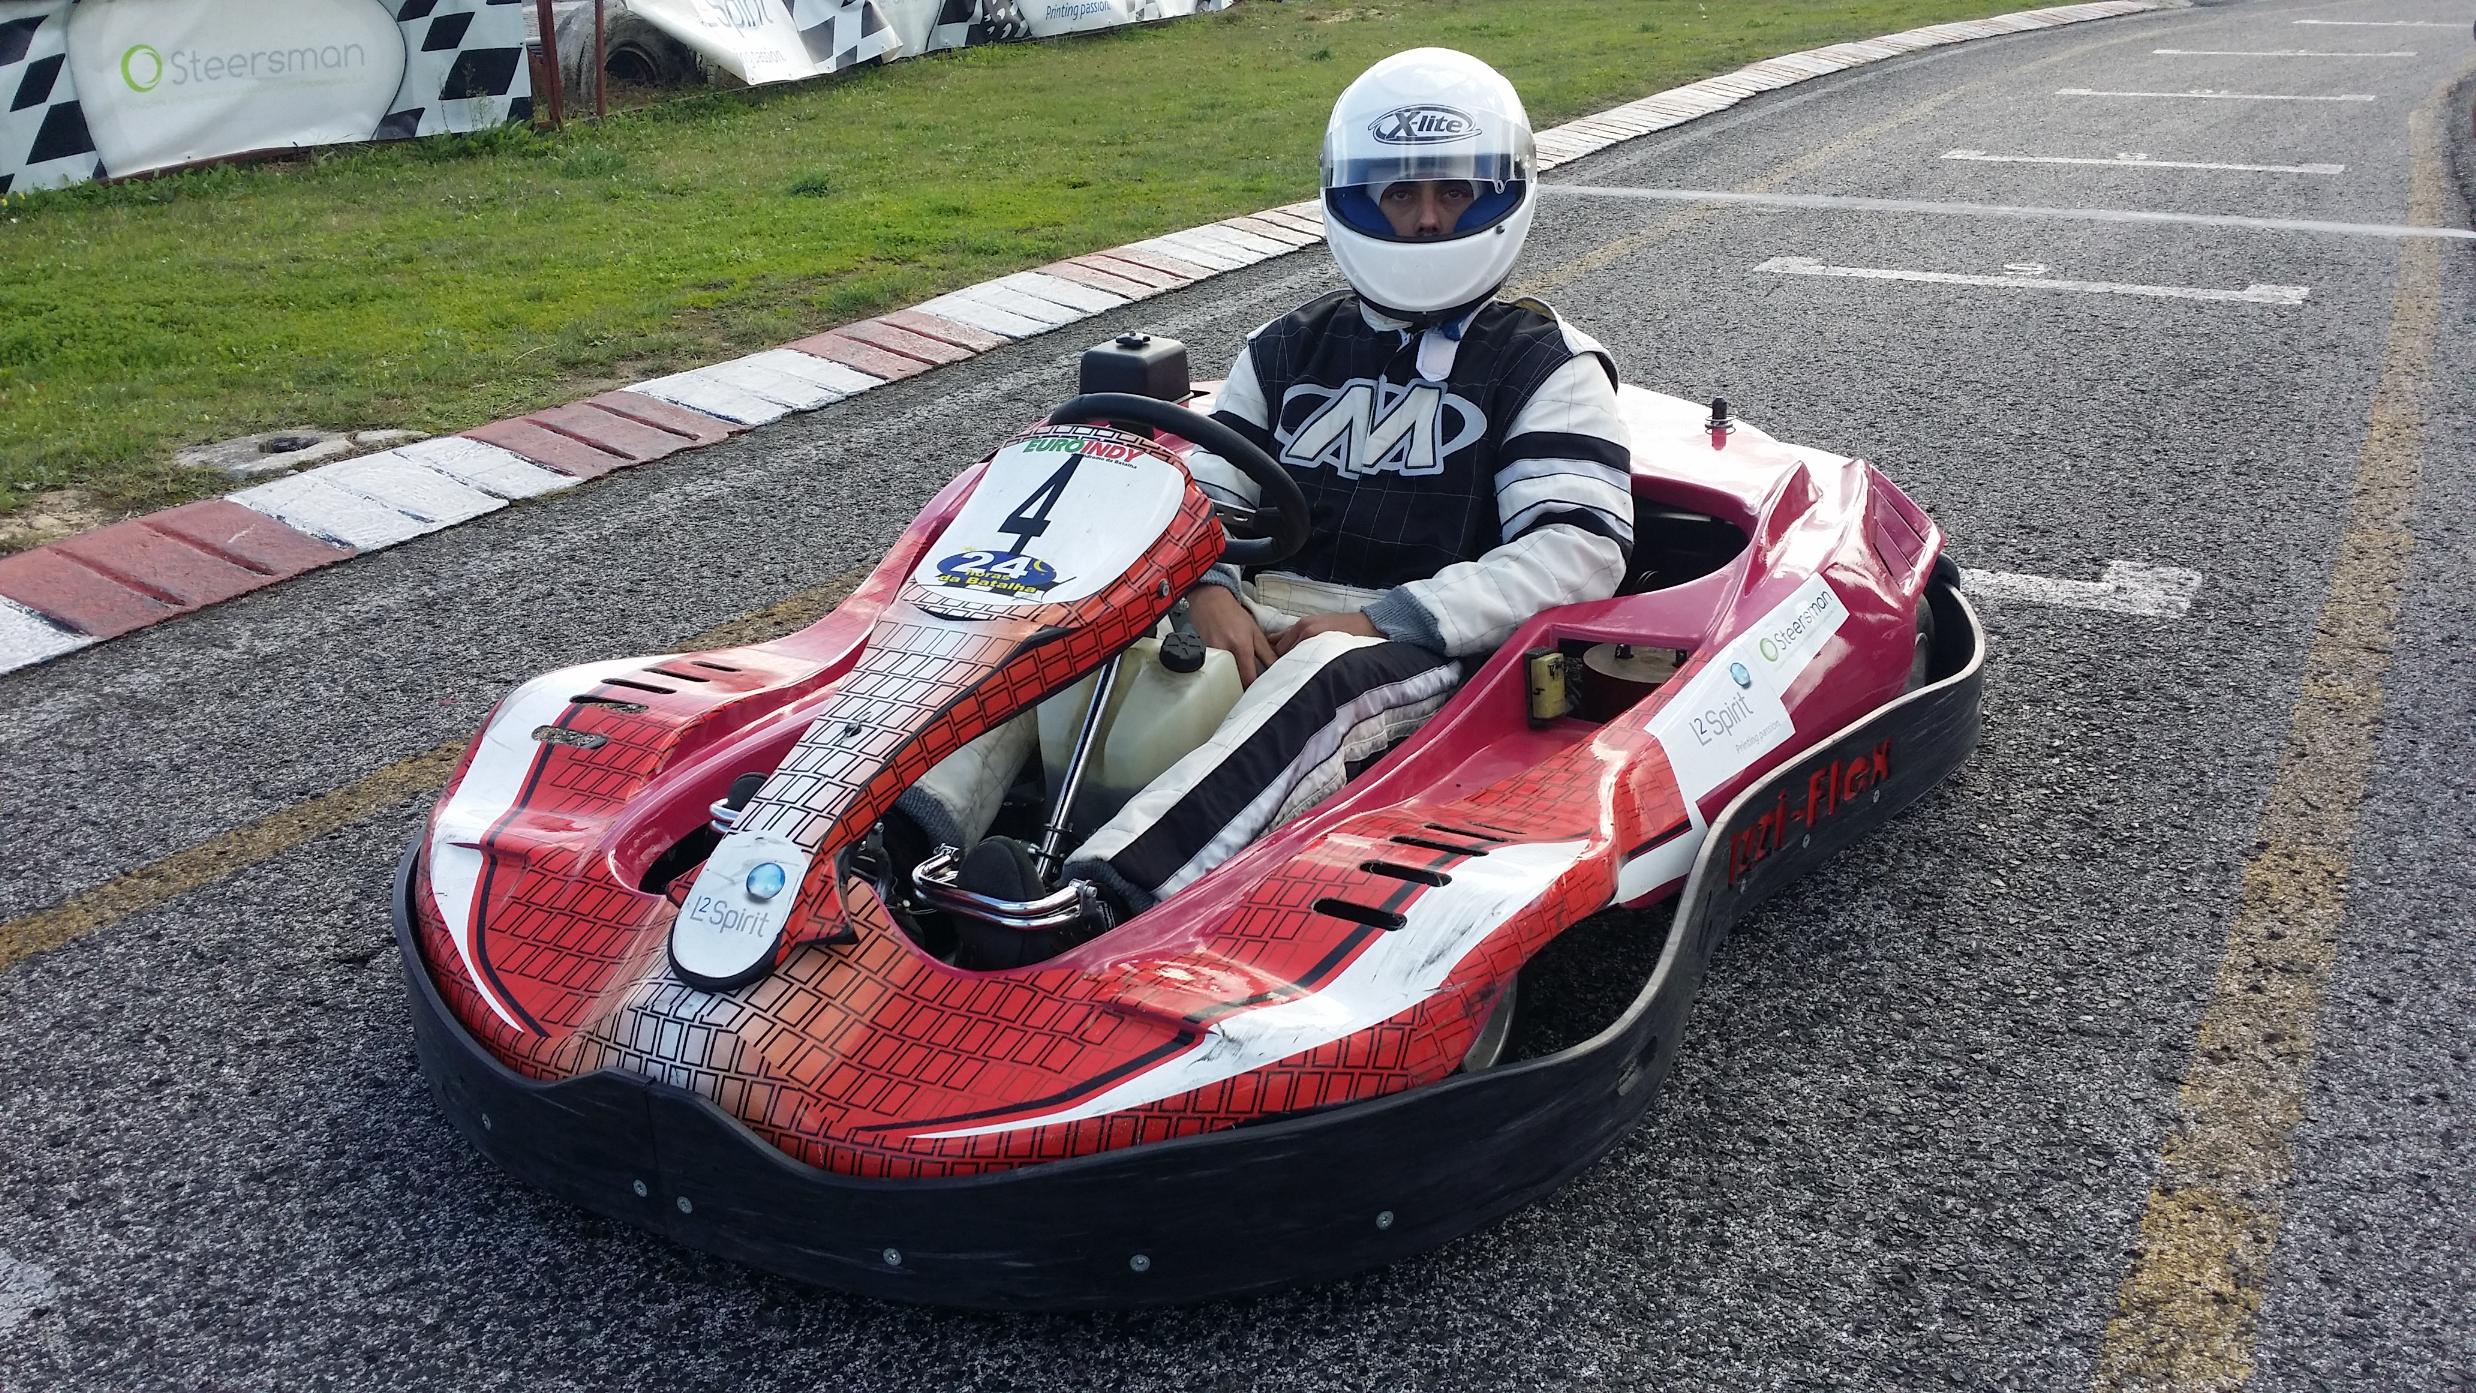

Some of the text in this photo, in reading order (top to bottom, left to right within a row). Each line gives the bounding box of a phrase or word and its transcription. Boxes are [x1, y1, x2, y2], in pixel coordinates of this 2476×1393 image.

[1045, 3, 1079, 20] Printing
[171, 43, 365, 85] Steersman
[1385, 109, 1464, 140] X-lite
[1023, 438, 1145, 462] EUROINDY
[997, 453, 1083, 555] 4
[951, 551, 1032, 579] 24
[966, 568, 1011, 581] horas
[938, 574, 1038, 594] da Batalha
[1774, 590, 1833, 651] Steersman
